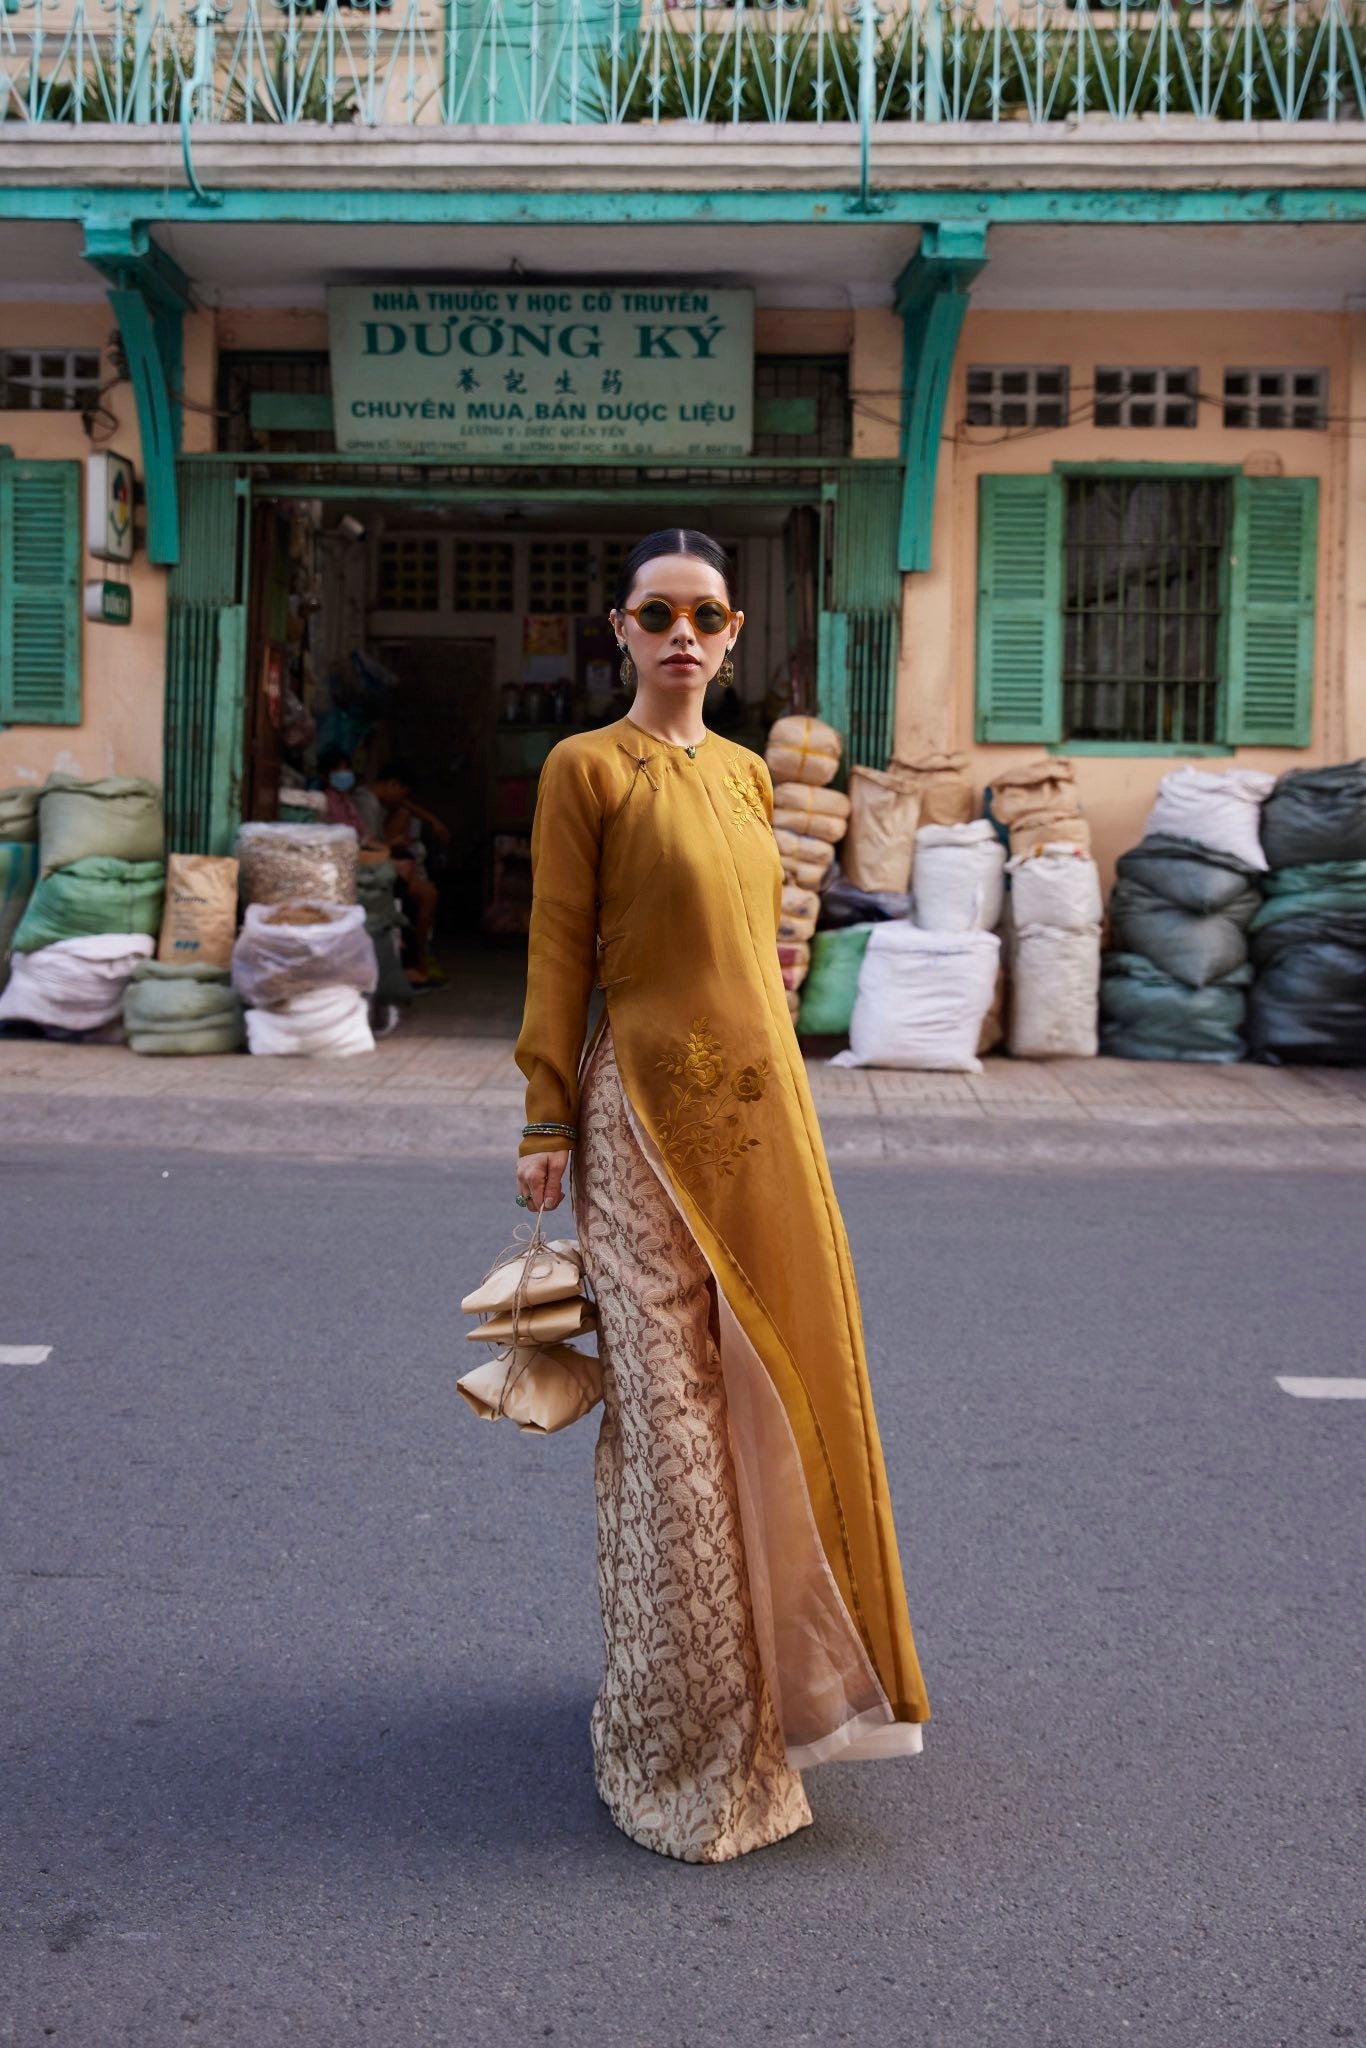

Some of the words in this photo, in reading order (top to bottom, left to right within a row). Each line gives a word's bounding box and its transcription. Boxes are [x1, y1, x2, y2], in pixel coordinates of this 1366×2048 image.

[373, 288, 420, 311] NHÀ
[427, 288, 499, 311] THUỐC
[506, 293, 518, 311] Y
[528, 293, 572, 317] HỌC
[362, 315, 604, 358] DƯỠNG
[634, 315, 727, 358] KÝ
[351, 399, 456, 419] CHUYÊN
[597, 403, 667, 425] DƯỢC
[679, 402, 735, 424] LIỆU
